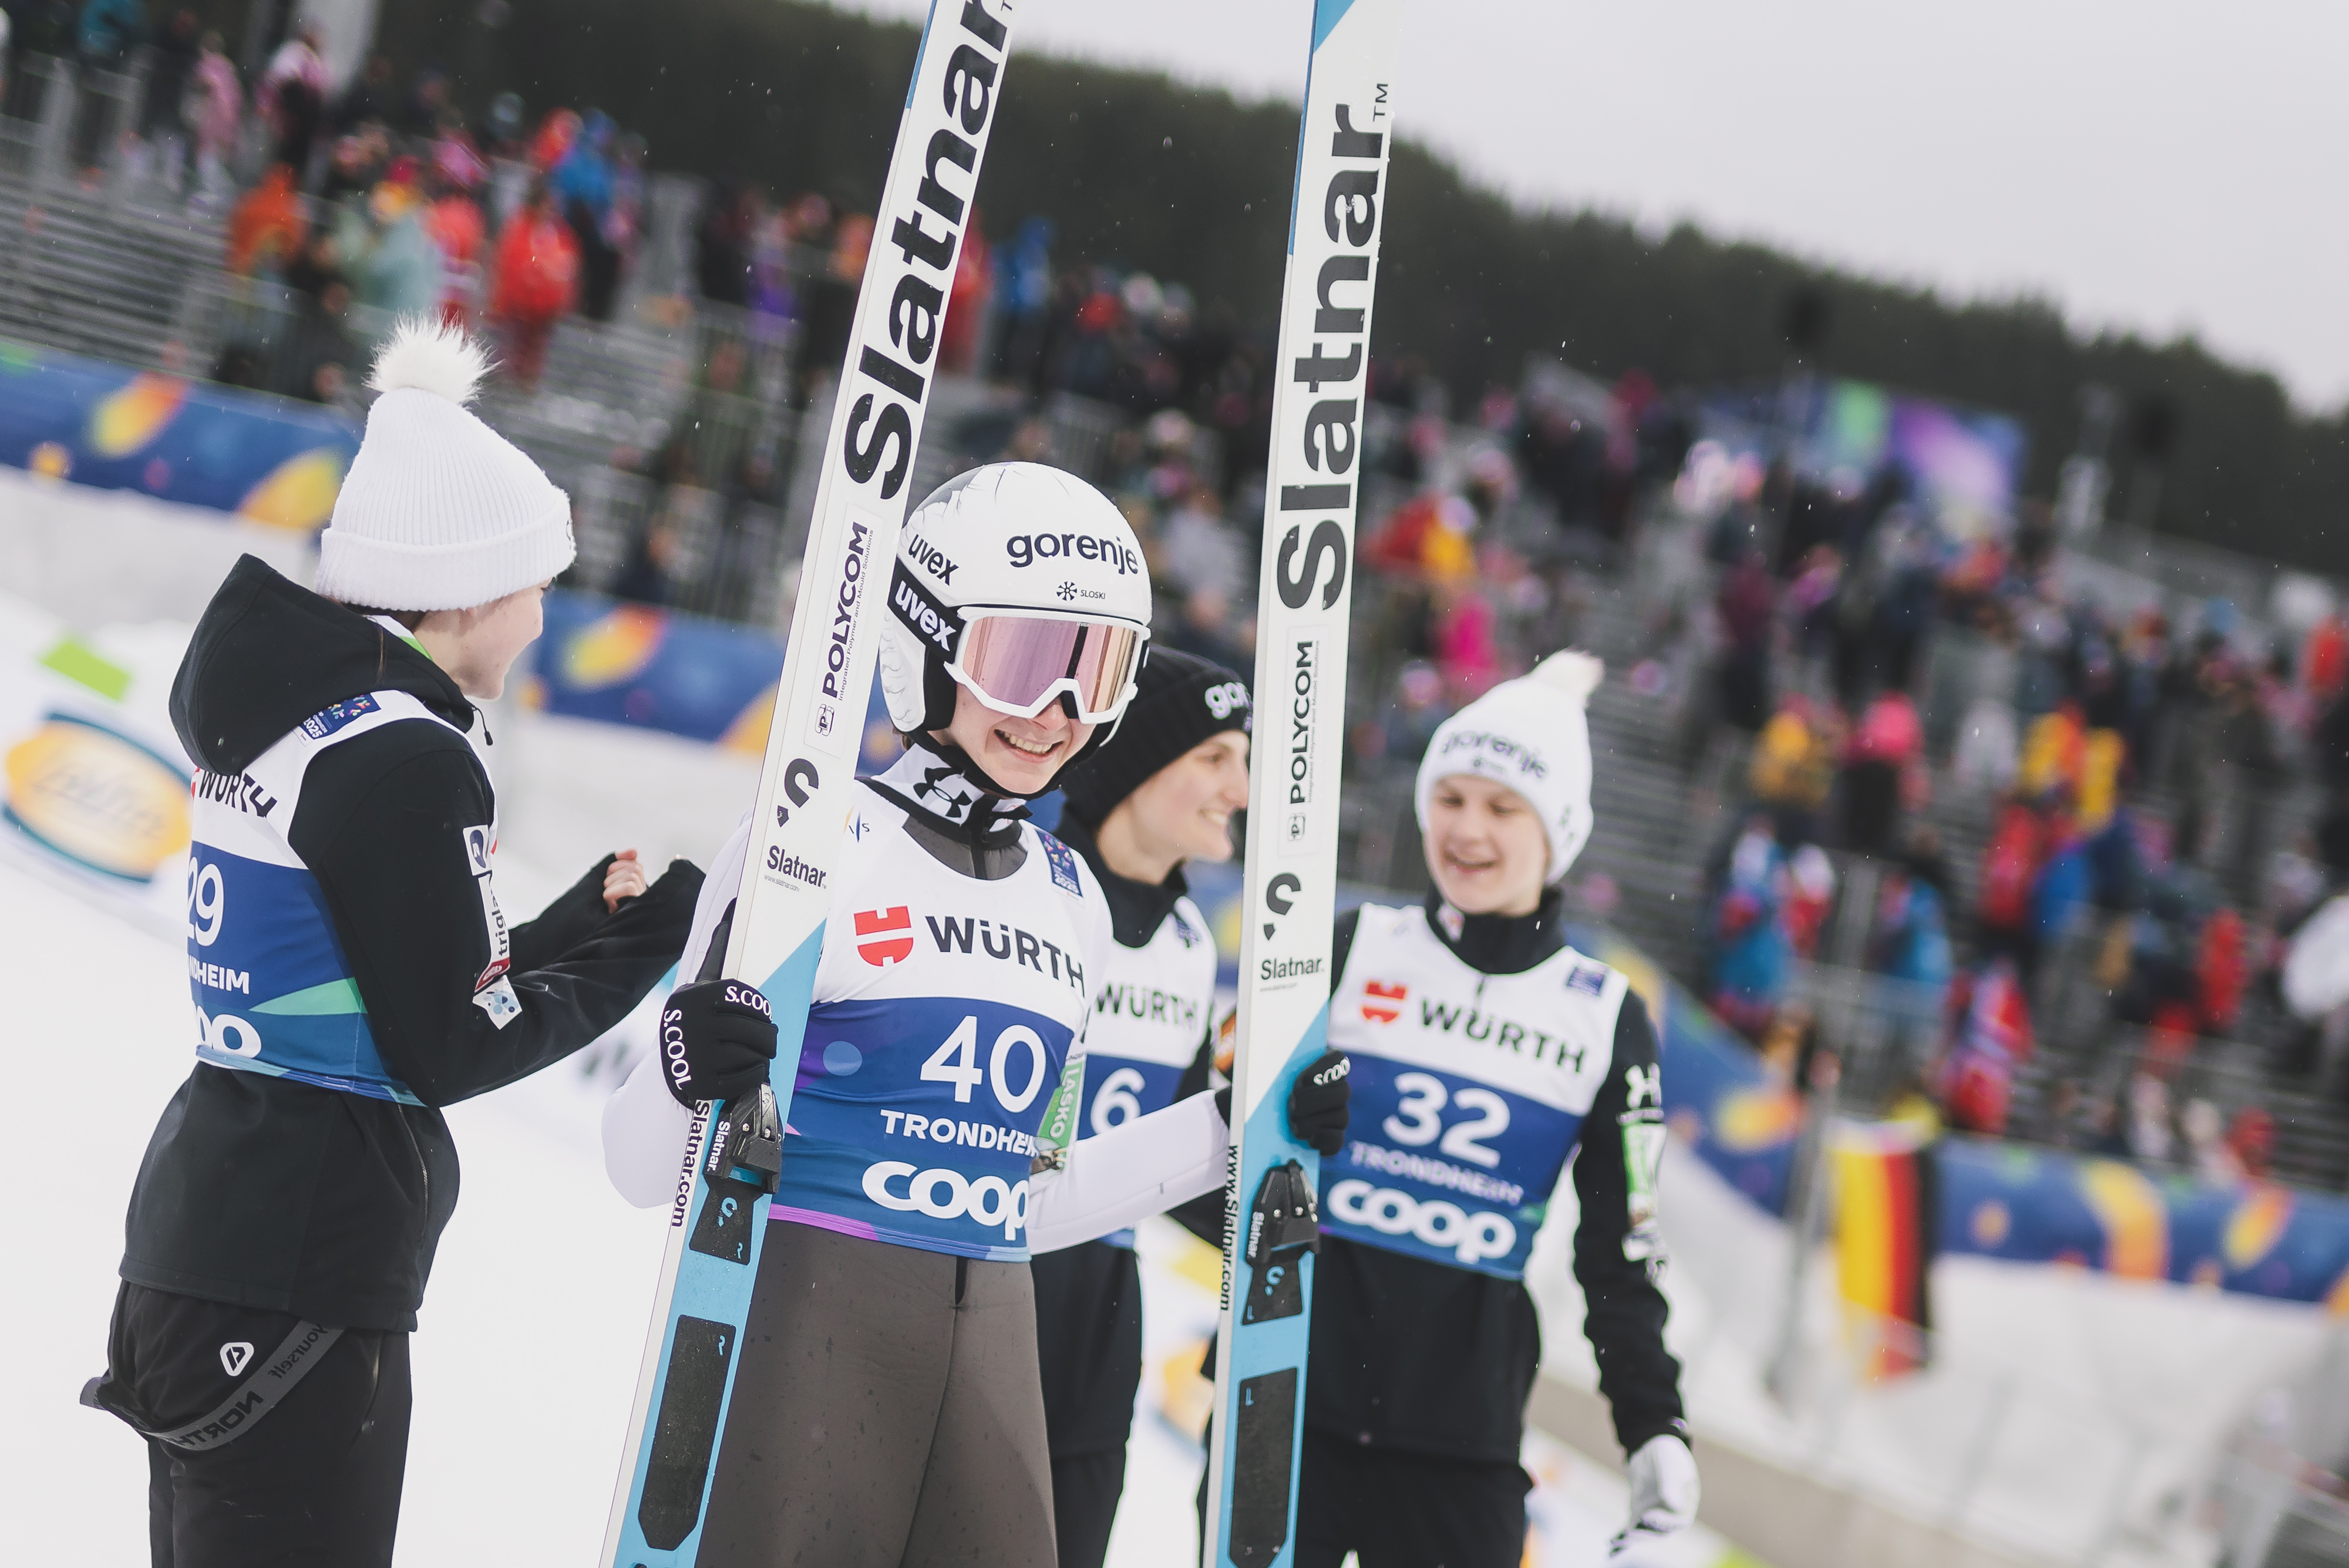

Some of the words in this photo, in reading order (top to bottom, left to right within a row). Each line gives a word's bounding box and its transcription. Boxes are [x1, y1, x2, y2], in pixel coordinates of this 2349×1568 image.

[844, 0, 1008, 499] Slatnar
[1277, 103, 1384, 610] Slatnar
[908, 534, 959, 586] uvex
[1007, 533, 1138, 575] gorenje
[822, 521, 868, 698] POLYCOM
[838, 657, 850, 701] Integrated
[847, 619, 857, 655] Polymer
[857, 572, 866, 599] Mould
[862, 530, 873, 569] Solutions
[895, 580, 956, 651] uvex
[1080, 589, 1106, 600] SLOSKI
[1290, 640, 1313, 803] POLYCOM
[188, 856, 224, 947] 29
[764, 874, 800, 893] www.slatnar.com
[767, 845, 826, 887] Slatnar
[188, 954, 250, 995] NDHEIM
[925, 916, 1085, 998] WÜRTH
[1261, 957, 1322, 980] Slatnar
[1097, 982, 1198, 1032] WÜRTH
[1421, 997, 1586, 1075] WÜRTH
[664, 1010, 692, 1091] S.COOL
[920, 1015, 1046, 1113] 40
[1091, 1067, 1146, 1135] 6
[1383, 1072, 1511, 1169] 32
[708, 1121, 731, 1171] Slatnar
[1350, 1140, 1525, 1207] TRONDHEIM
[862, 1160, 1029, 1241] coop
[1220, 1145, 1239, 1311] www.Slatnar.com
[1247, 1211, 1265, 1259] Slatnar
[1327, 1178, 1517, 1264] coop
